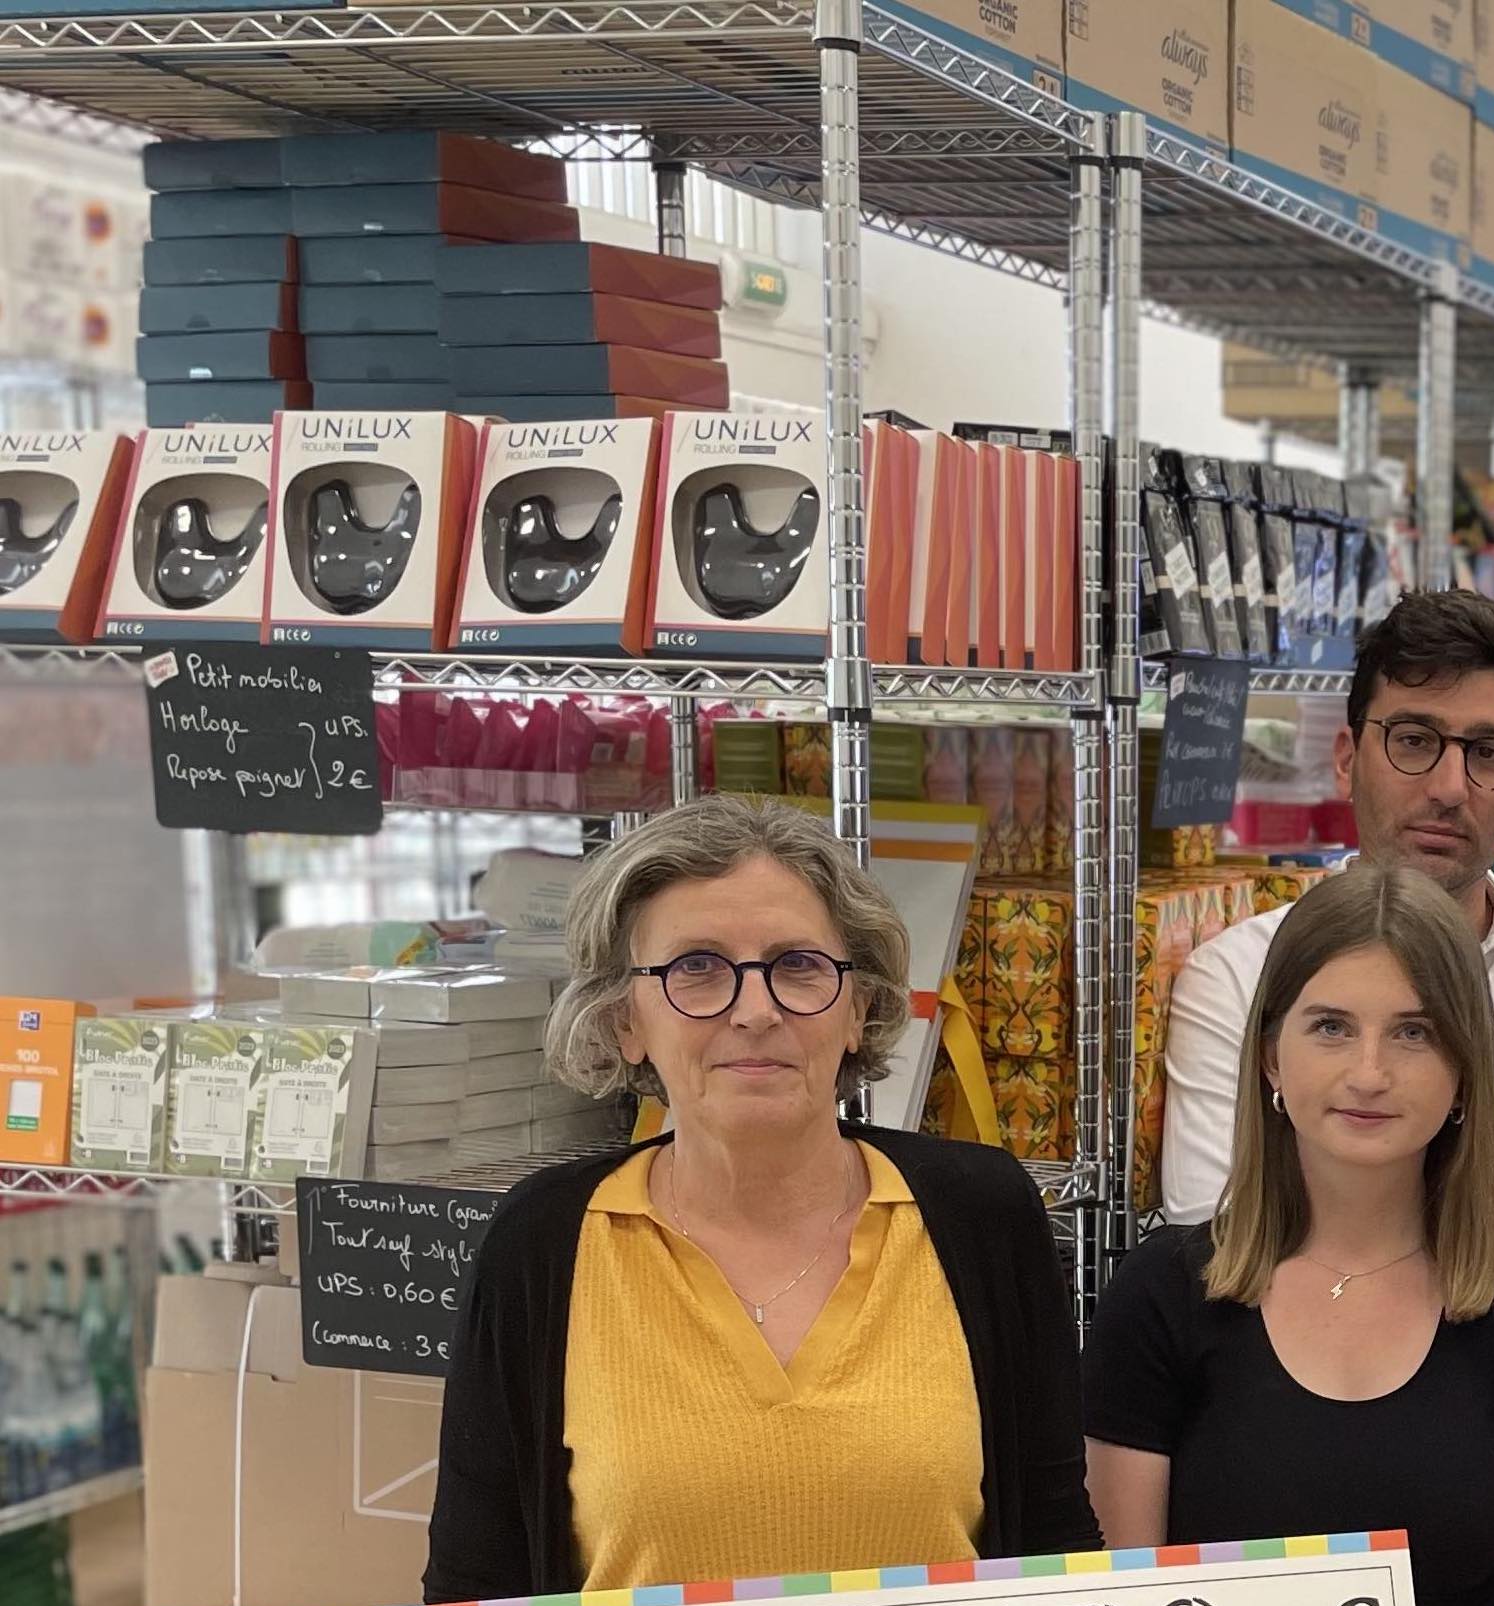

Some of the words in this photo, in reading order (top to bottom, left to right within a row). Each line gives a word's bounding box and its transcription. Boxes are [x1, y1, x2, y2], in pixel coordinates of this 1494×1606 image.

[979, 5, 1016, 34] COTTON
[1161, 28, 1208, 87] always
[0, 433, 87, 452] NiLUX
[186, 653, 232, 689] Petit
[160, 701, 249, 754] Horloge
[167, 754, 227, 790] Repose
[331, 1184, 439, 1217] Fourniture
[322, 1221, 374, 1247] Tout
[318, 1272, 363, 1296] UPS
